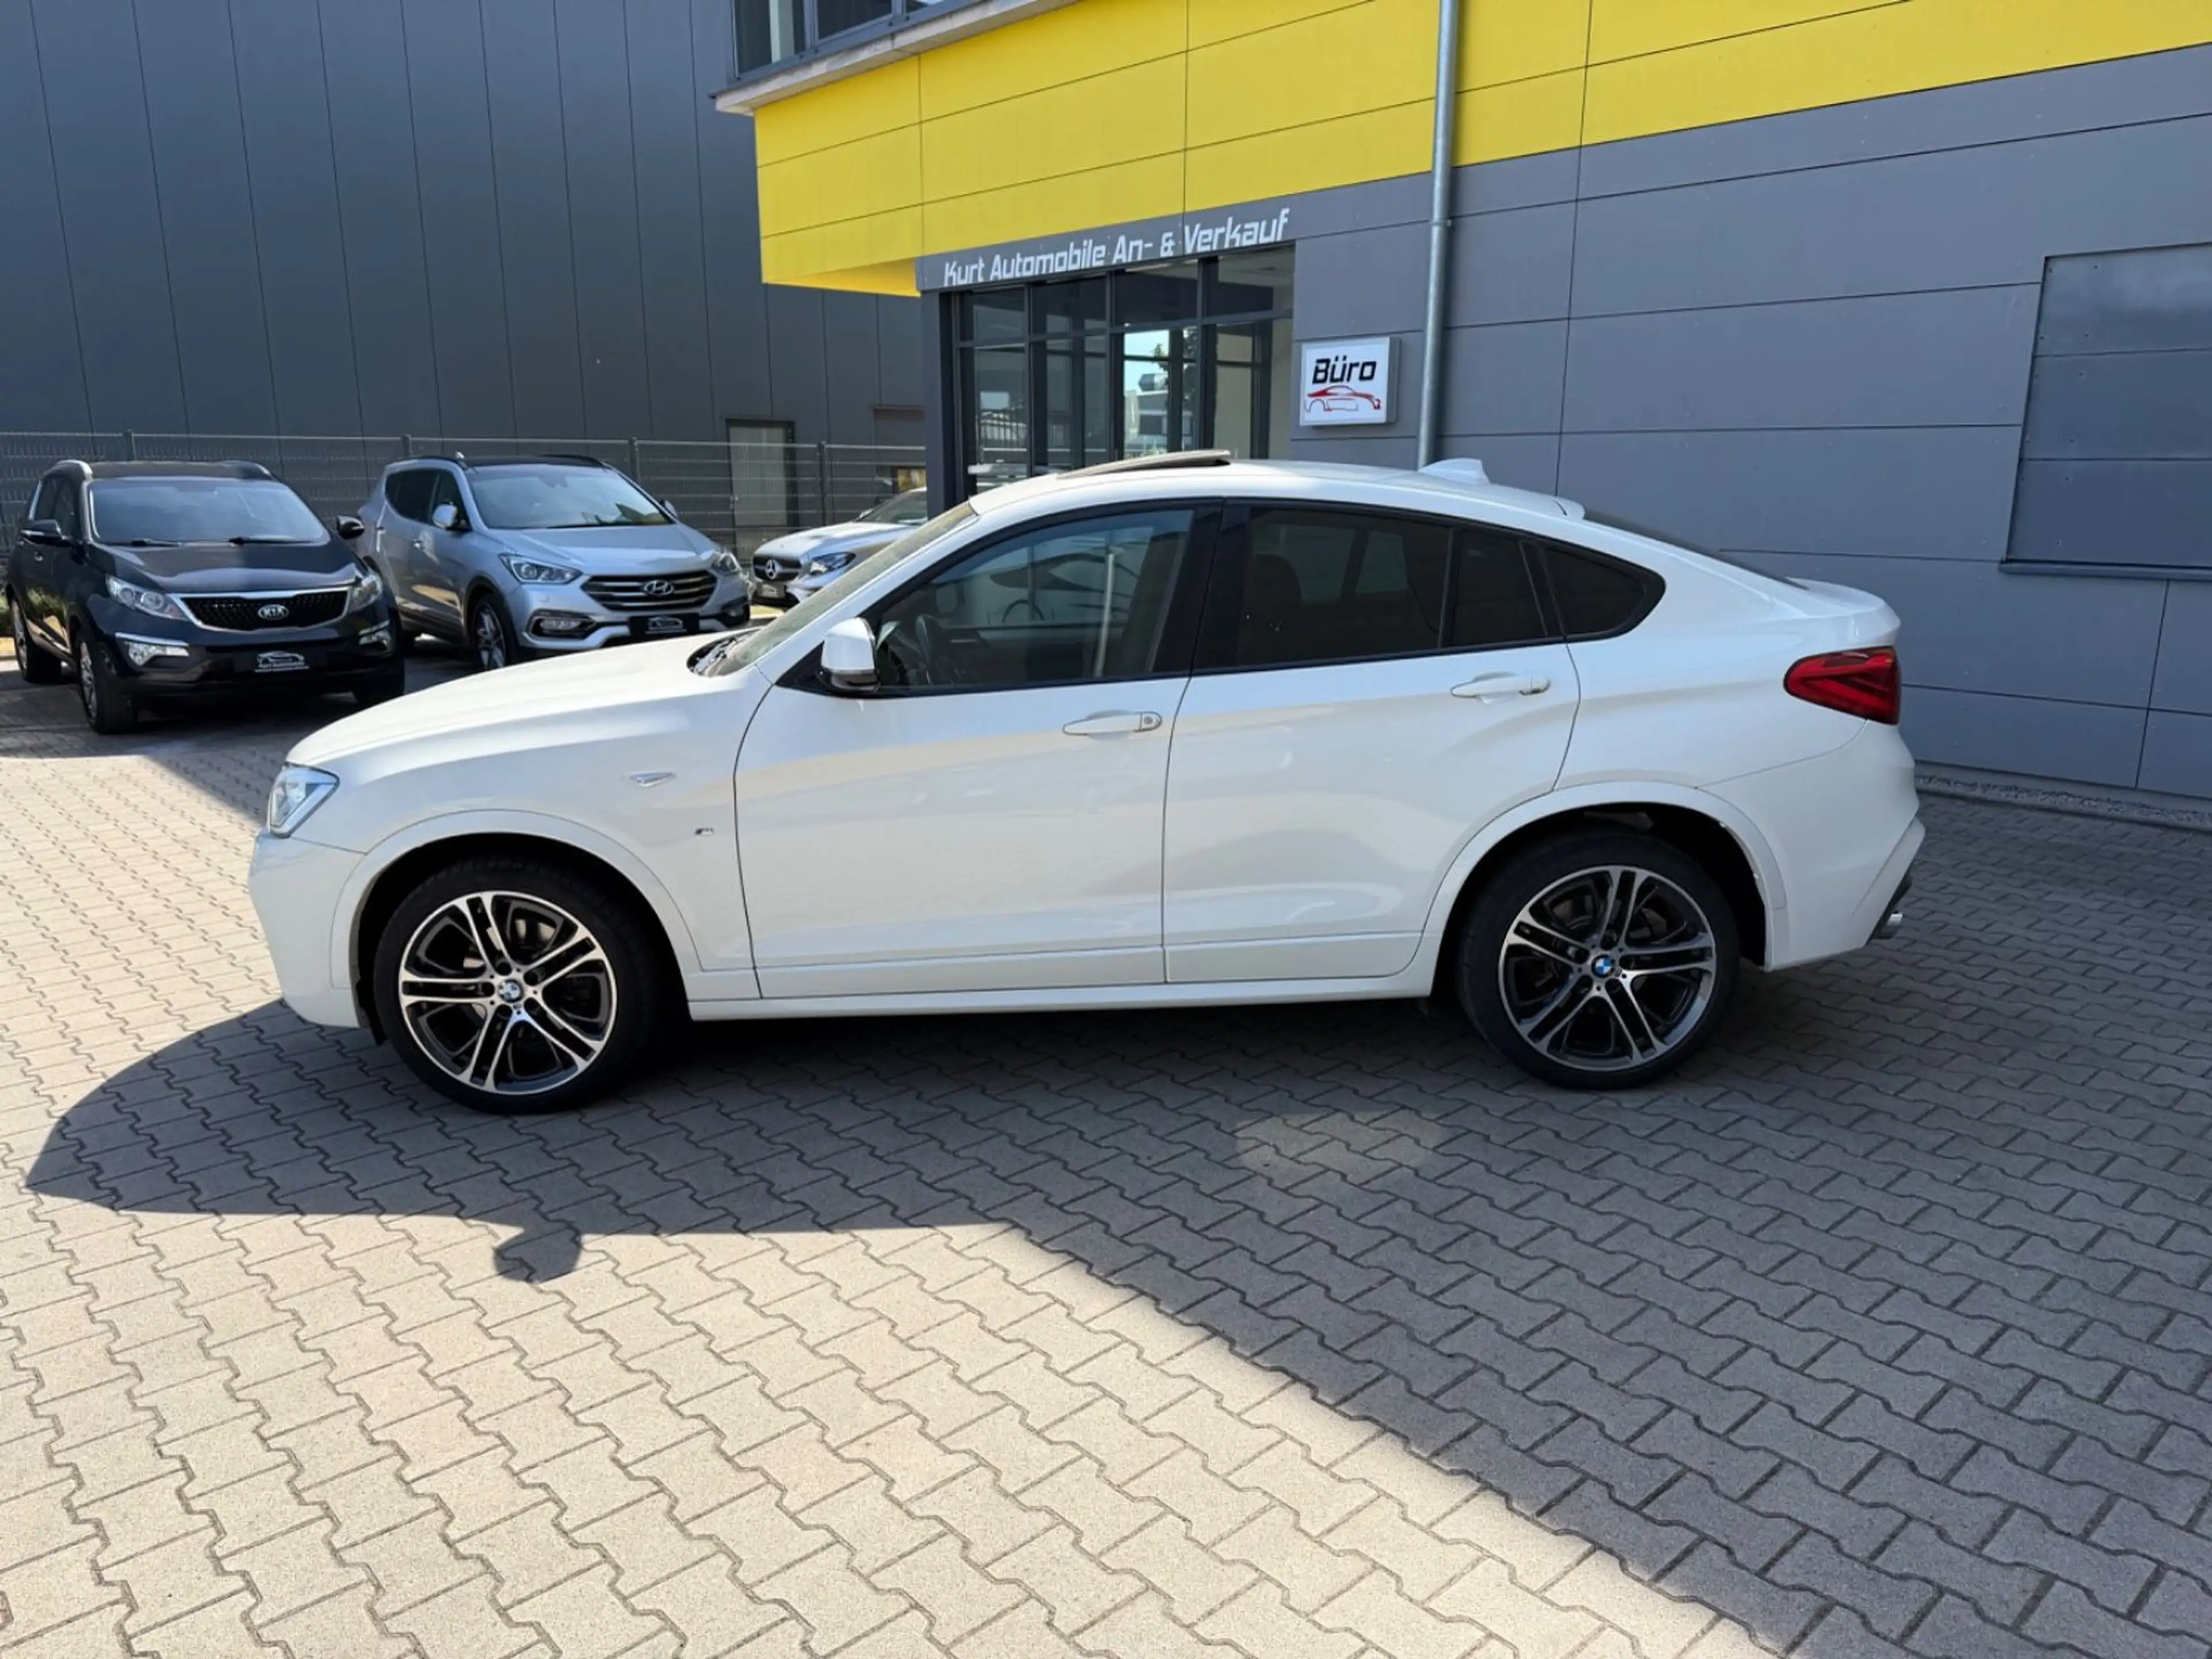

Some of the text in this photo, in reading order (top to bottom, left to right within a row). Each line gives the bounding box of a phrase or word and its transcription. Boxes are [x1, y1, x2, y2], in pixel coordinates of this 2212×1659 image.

[944, 207, 1290, 287] Kurt Automobile An- & Verkauf
[1312, 355, 1377, 384] Büro
[260, 606, 287, 619] KIA
